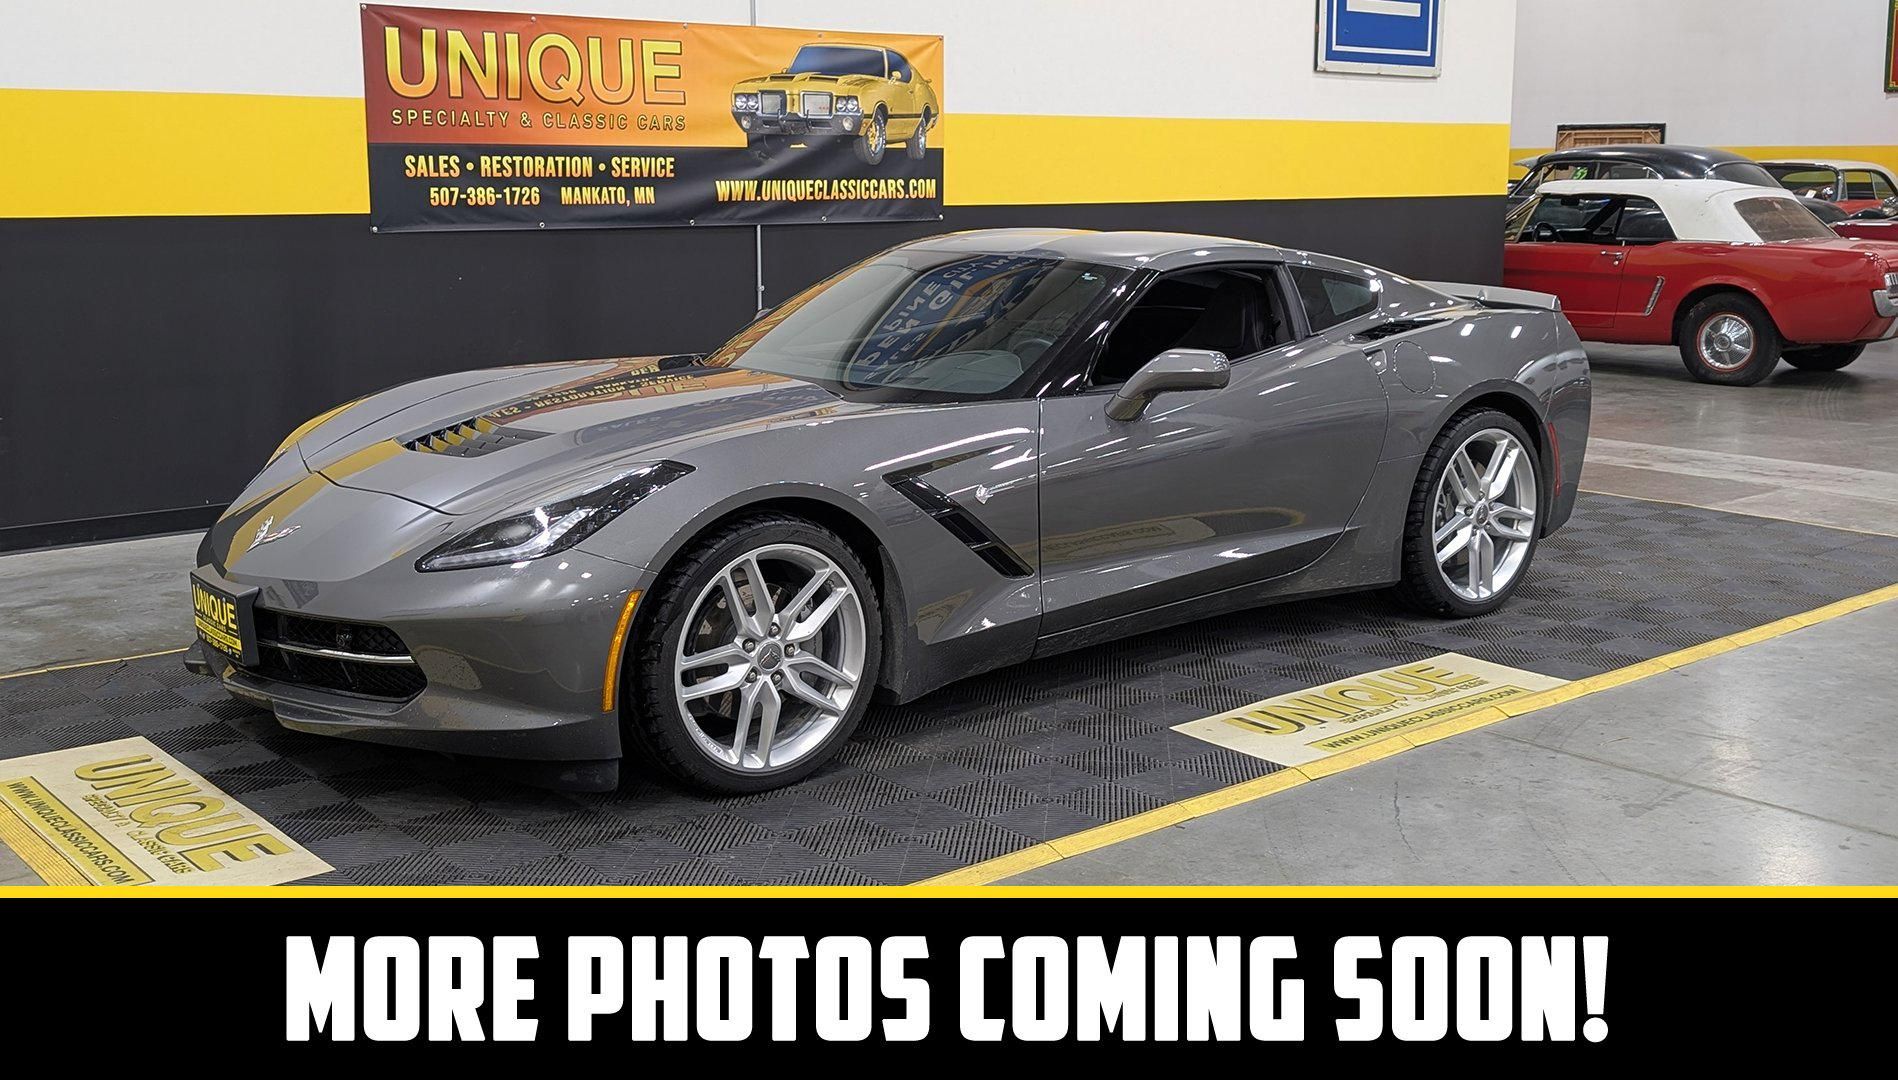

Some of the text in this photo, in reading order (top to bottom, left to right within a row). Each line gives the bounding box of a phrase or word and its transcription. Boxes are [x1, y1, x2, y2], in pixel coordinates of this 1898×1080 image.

[384, 26, 686, 106] UNIQUE
[391, 109, 686, 130] SPECIALTY & CLASSIC CARS
[405, 156, 675, 179] SALES RESTORATION SERVICE
[429, 186, 655, 208] 507-386-1726 MANKATO, MN
[714, 178, 937, 204] WWW.UNIQUECLASSICCARS.COM
[192, 583, 237, 629] UNIQUE
[1221, 663, 1480, 736] UNIQUE
[7, 781, 134, 884] WWW.UNIQUECLASSICCARS.COM
[74, 754, 295, 872] UNIQUE
